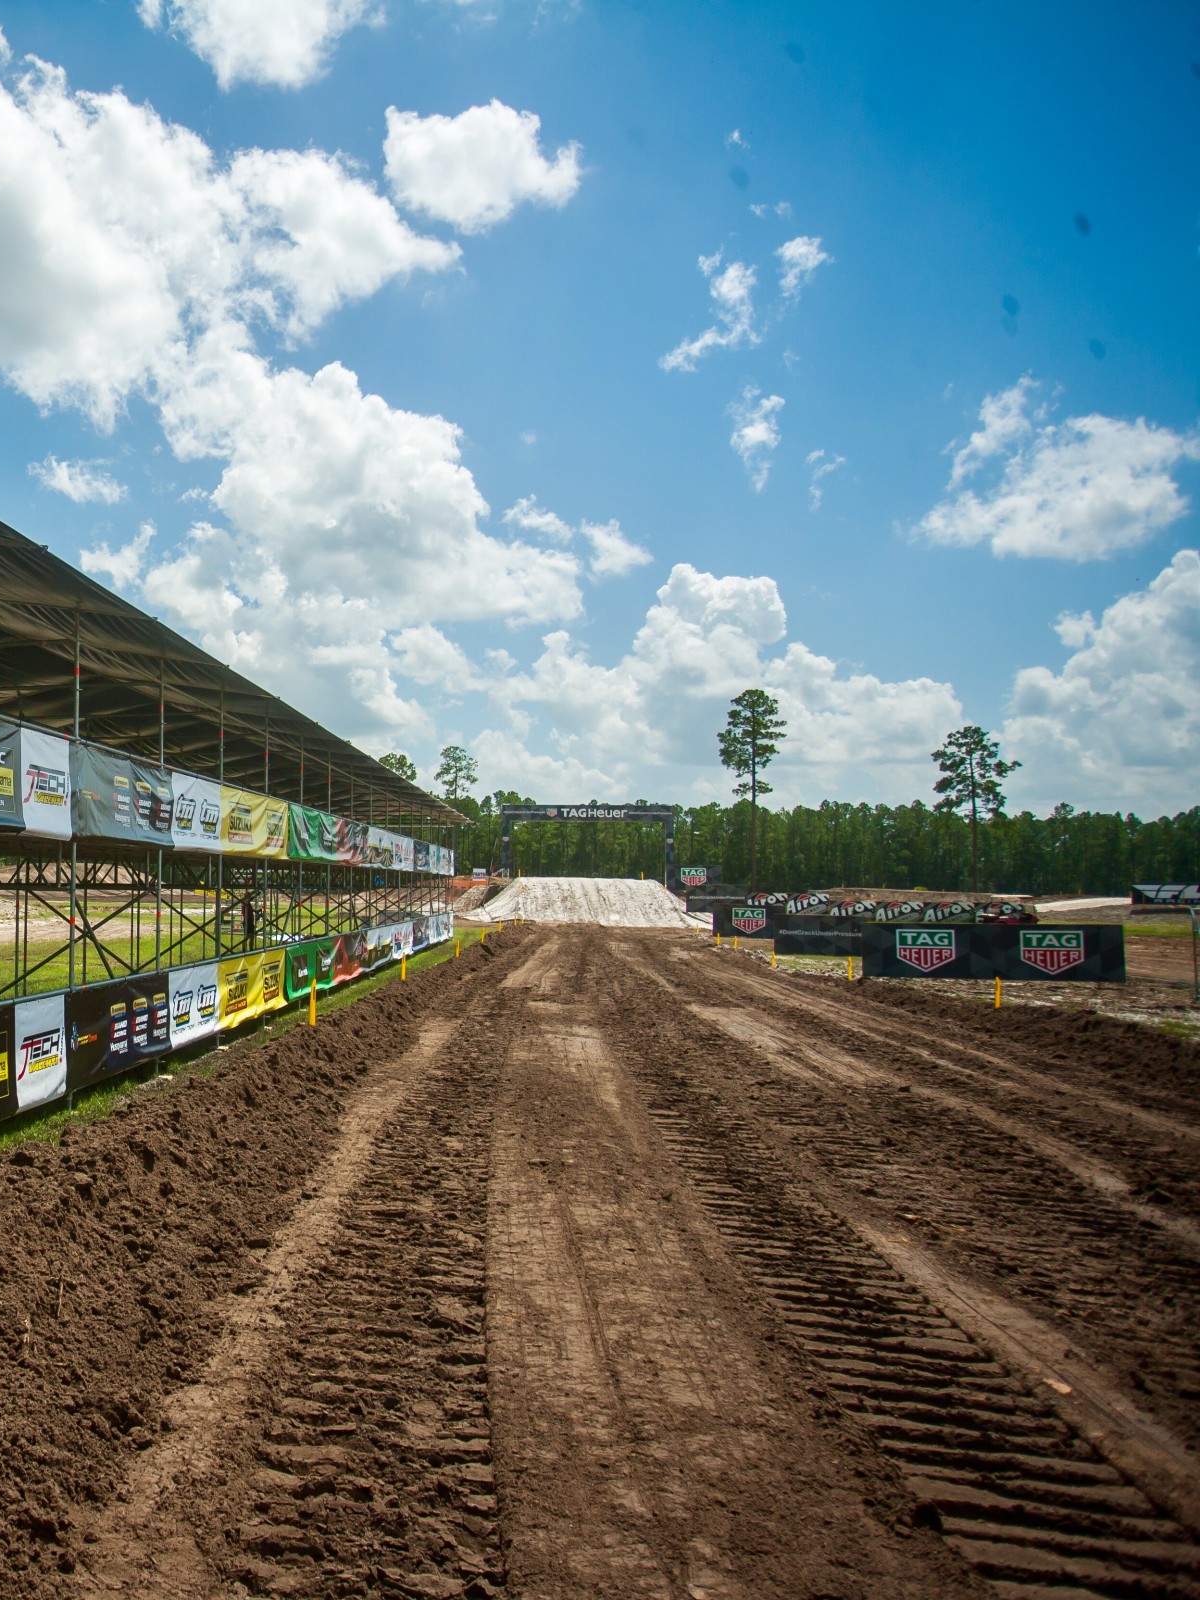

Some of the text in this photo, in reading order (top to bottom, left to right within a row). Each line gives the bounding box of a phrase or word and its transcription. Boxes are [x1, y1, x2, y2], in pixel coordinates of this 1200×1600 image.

[229, 815, 252, 833] SUZUKI
[682, 877, 705, 885] HEUER
[735, 910, 763, 918] TAG
[734, 920, 764, 931] HEUER
[902, 932, 949, 946] TAG
[1025, 934, 1077, 947] TAG
[900, 948, 951, 968] HEUER
[1024, 950, 1079, 970] HEUER
